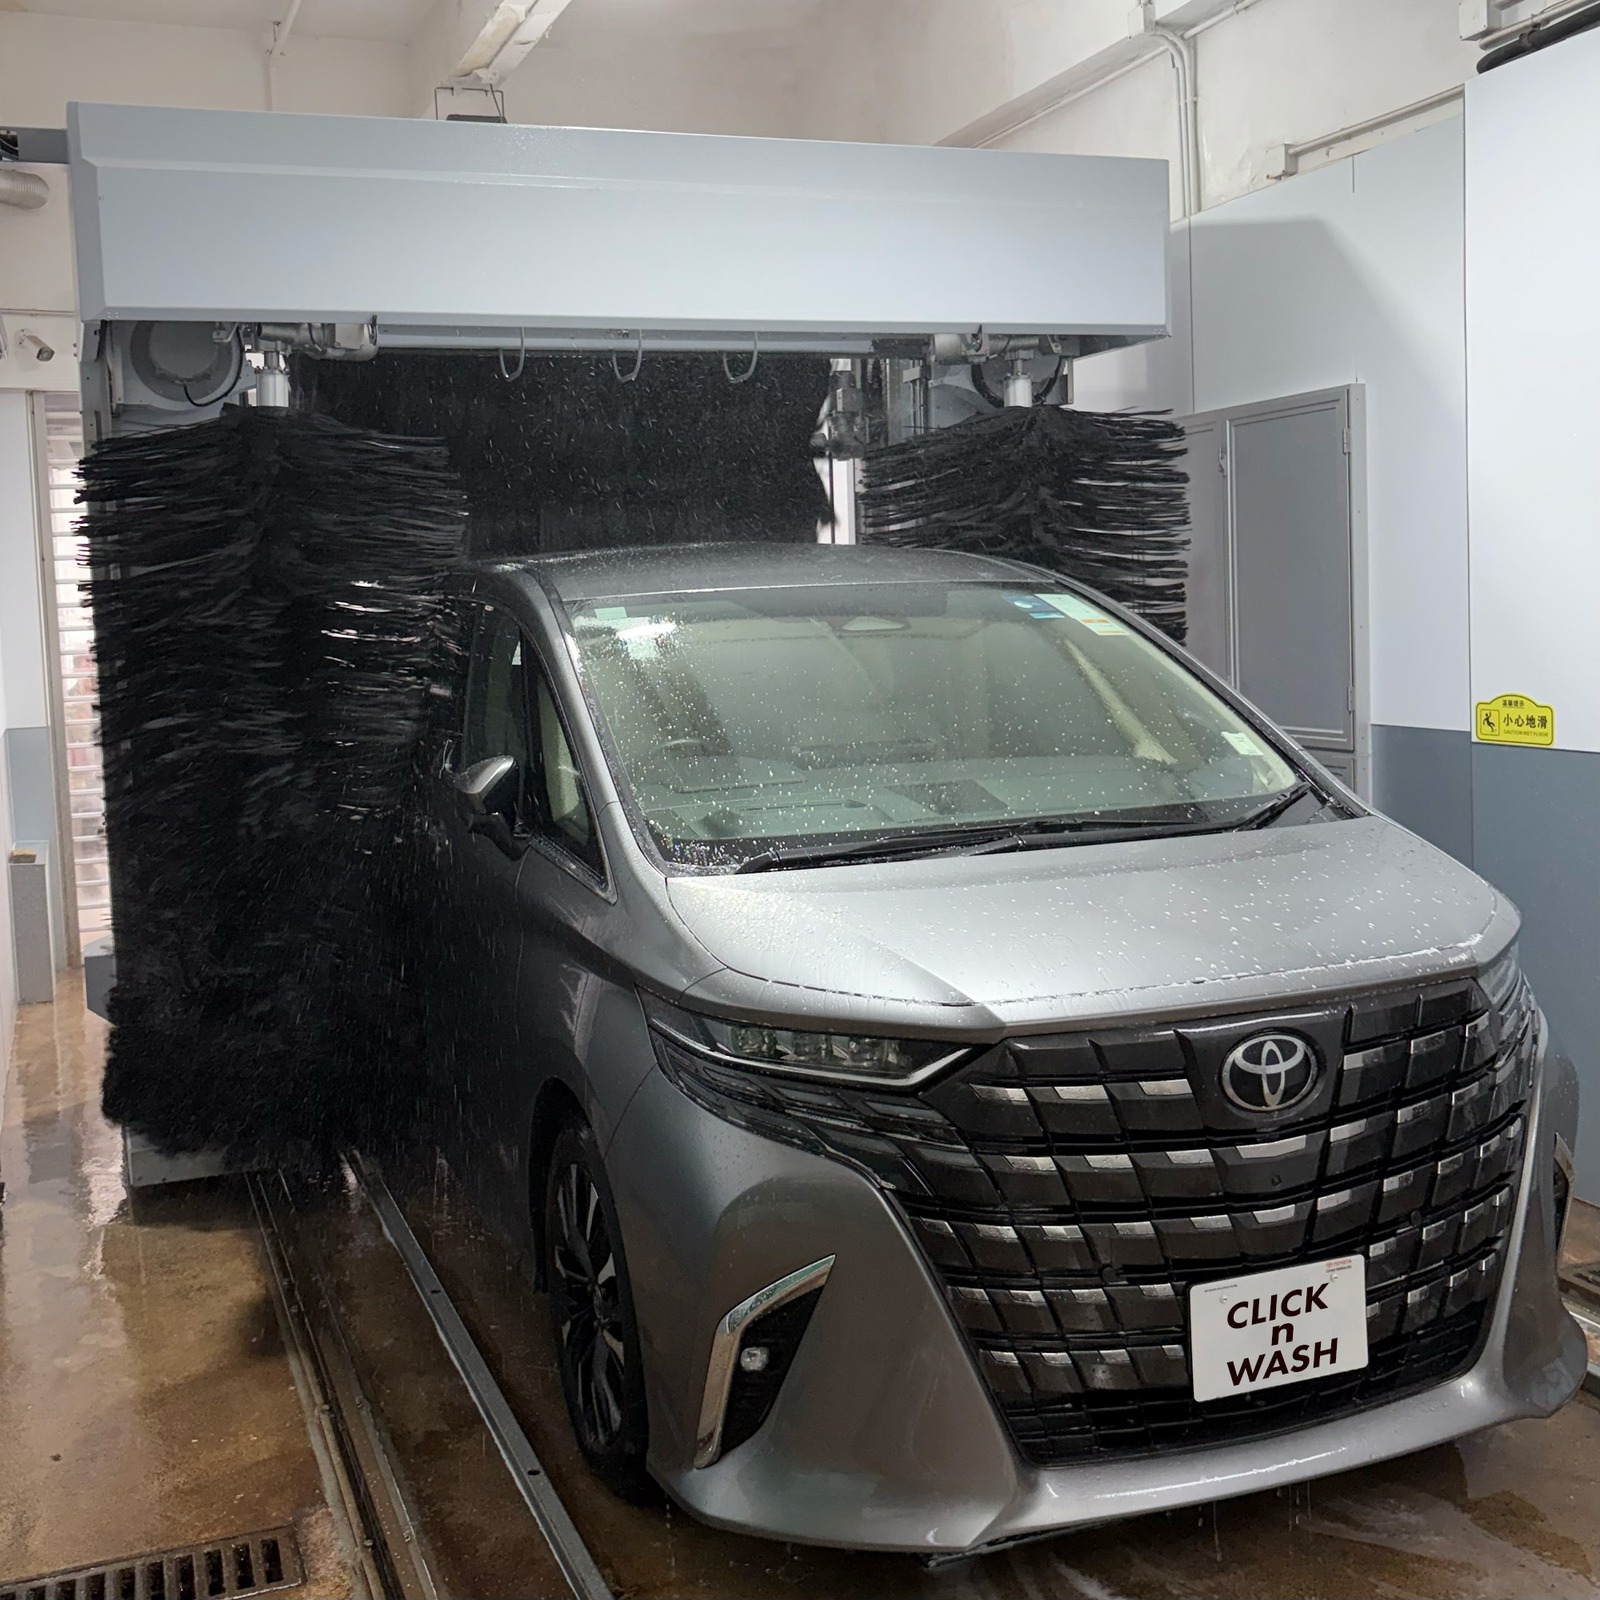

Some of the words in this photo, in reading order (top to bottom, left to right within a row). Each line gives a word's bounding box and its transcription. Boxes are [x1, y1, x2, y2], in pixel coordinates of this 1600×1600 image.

[1503, 713, 1548, 729] 小心地滑
[1227, 1282, 1329, 1329] CLICK
[1271, 1322, 1294, 1346] n
[1227, 1337, 1338, 1386] WASH
